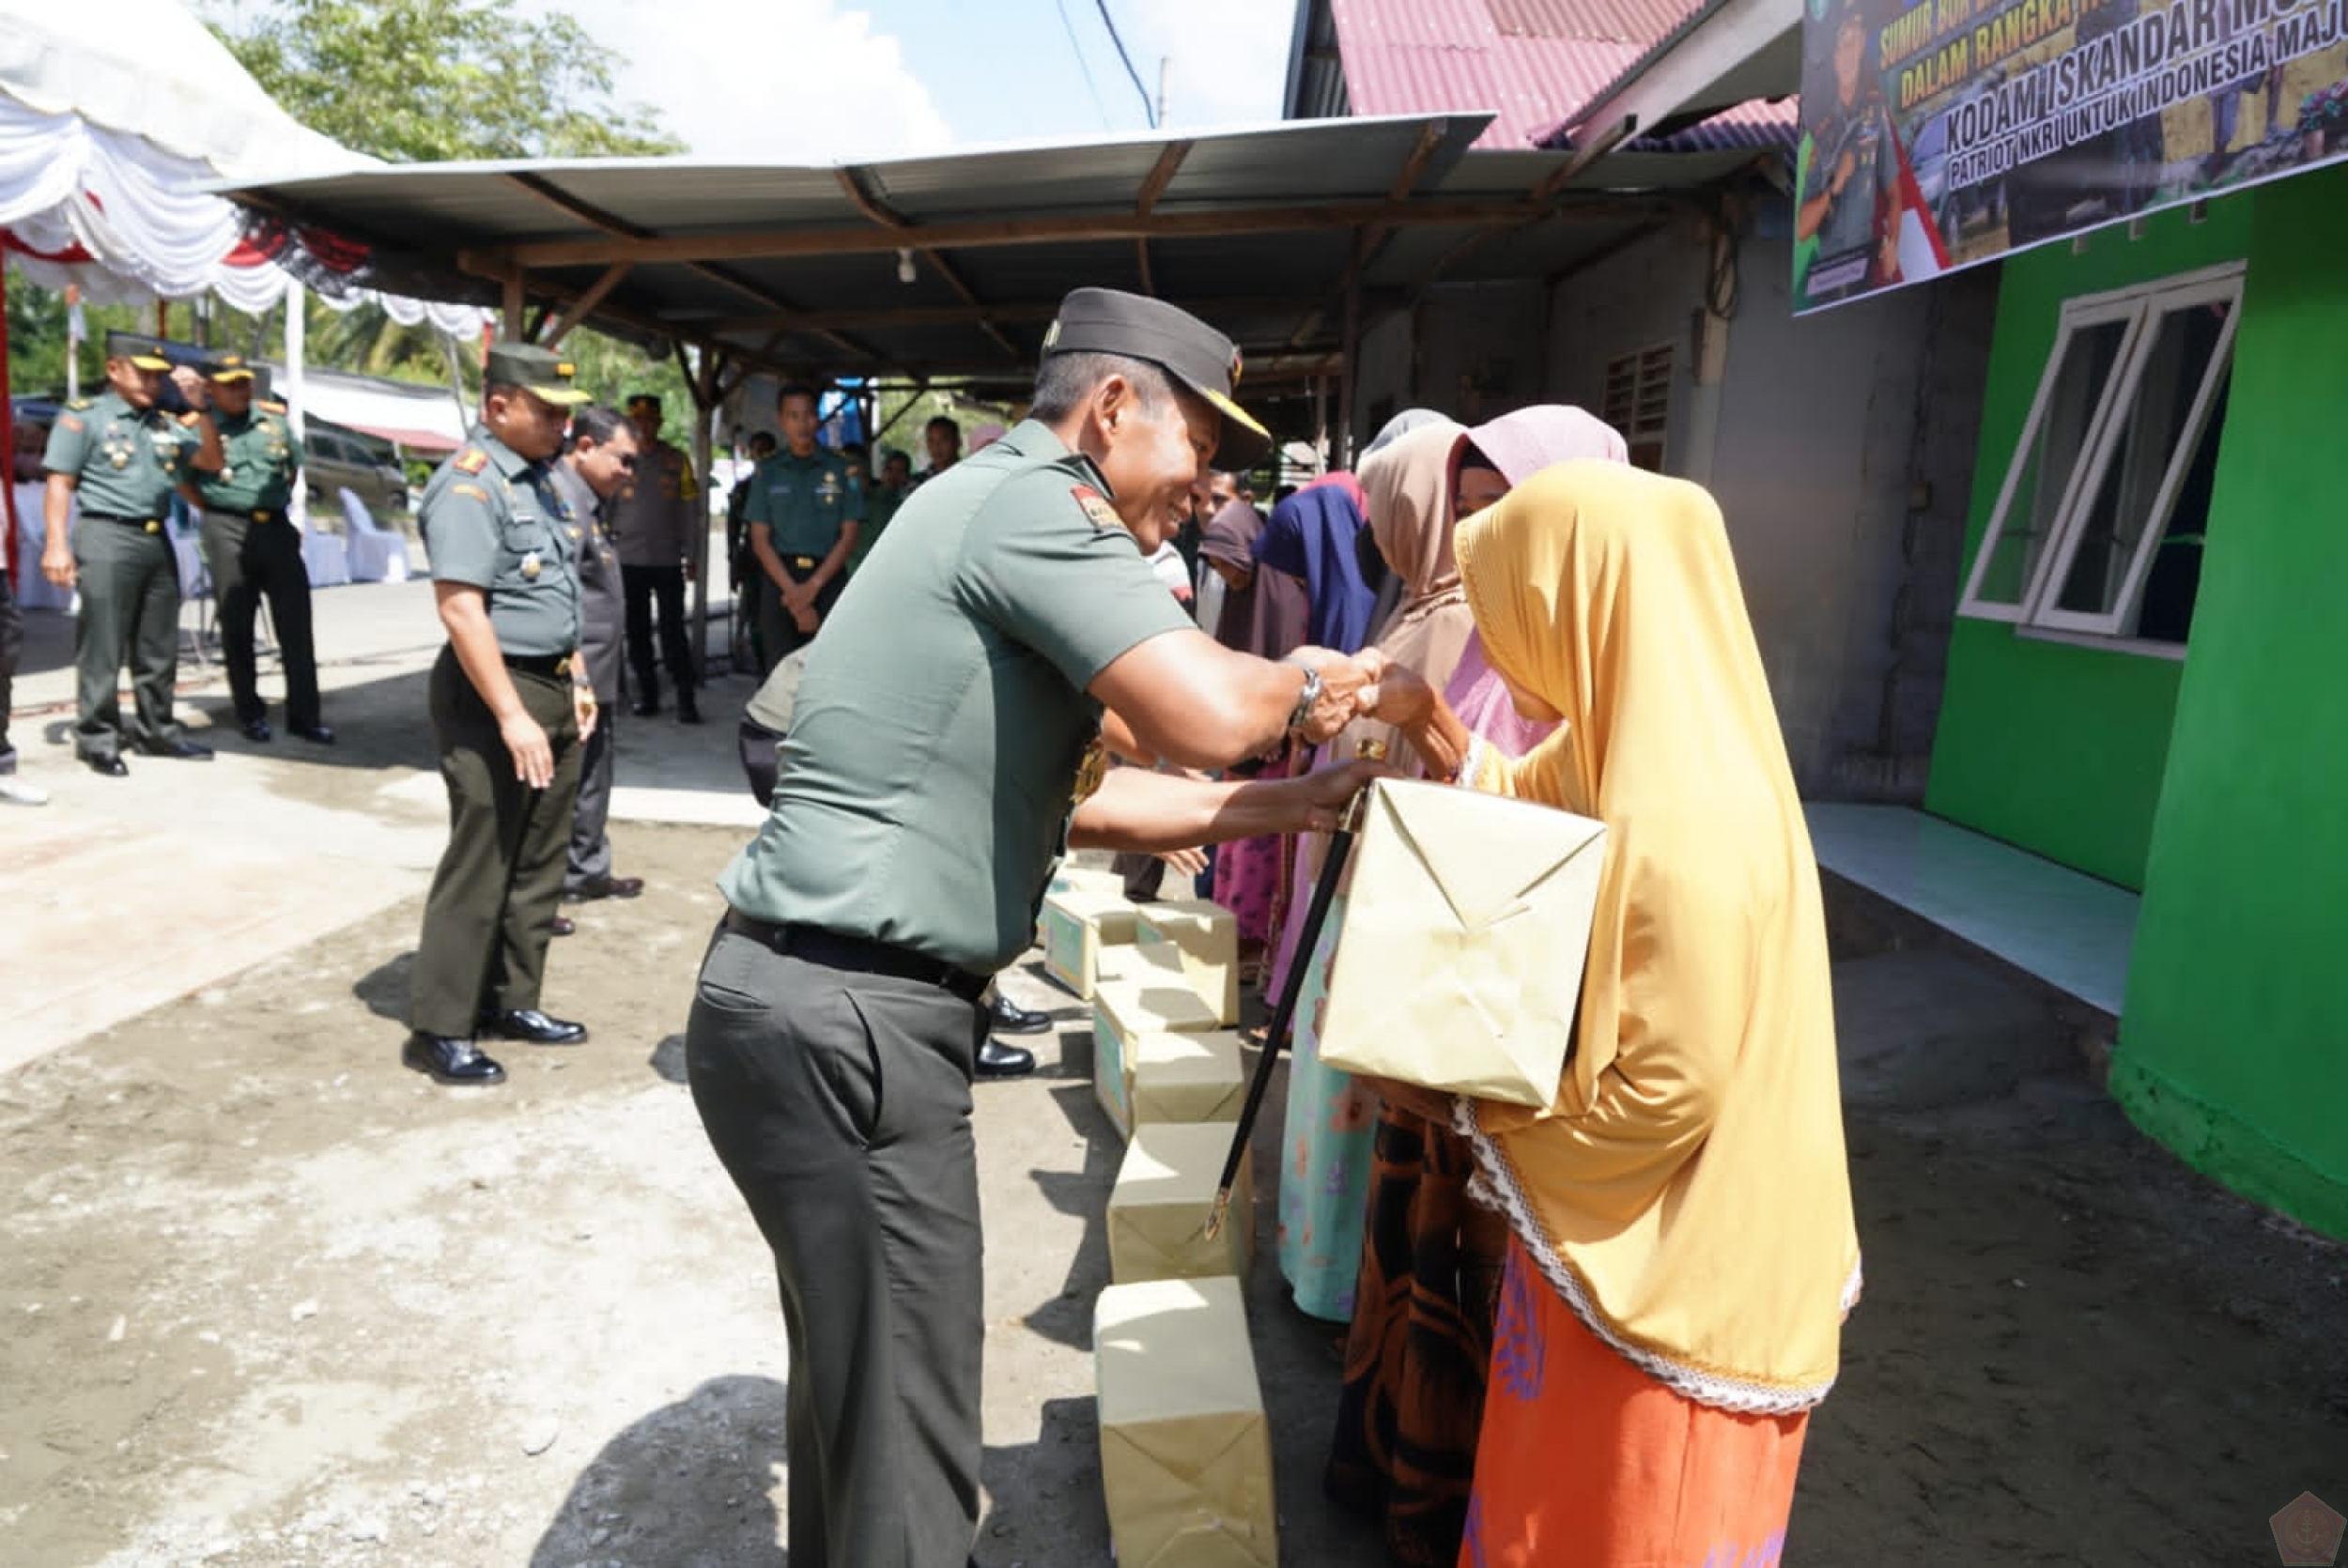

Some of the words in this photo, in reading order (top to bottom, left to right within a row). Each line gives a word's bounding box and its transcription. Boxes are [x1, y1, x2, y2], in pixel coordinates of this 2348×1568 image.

[1879, 3, 1931, 70] SUMUR
[1901, 38, 1969, 109] DALAM
[1974, 0, 2073, 70] RANGKA
[1947, 73, 2038, 155] KODAM
[2047, 0, 2217, 113] ISKANDAR
[1950, 135, 2015, 190] PATRIOT
[2019, 115, 2062, 161] NKRI
[2065, 89, 2132, 145] UNTUK
[2136, 33, 2267, 116] INDONESIA
